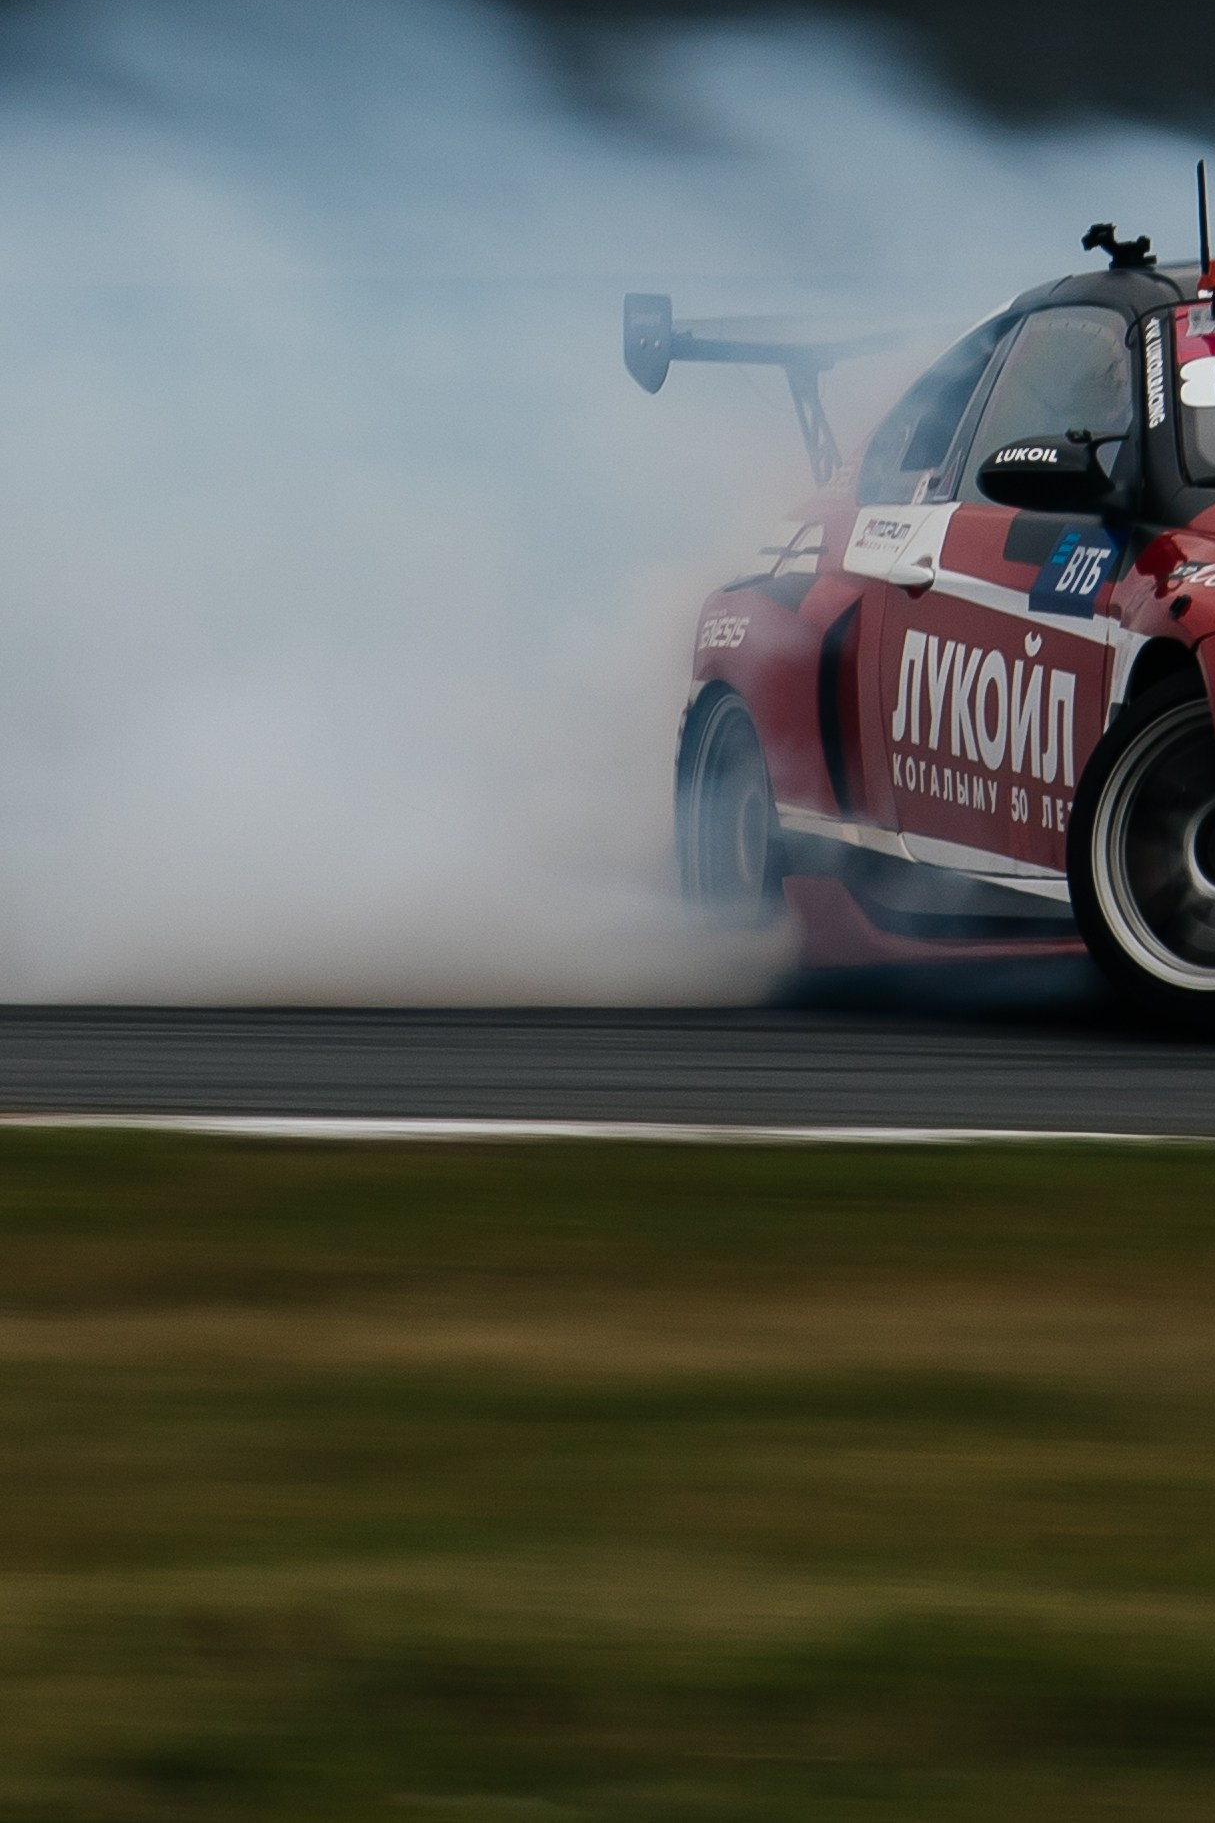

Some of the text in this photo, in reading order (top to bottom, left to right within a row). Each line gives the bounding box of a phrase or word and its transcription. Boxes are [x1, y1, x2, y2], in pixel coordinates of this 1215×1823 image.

[995, 447, 1058, 464] LUKOIL
[1055, 546, 1111, 595] ВТБ
[697, 617, 750, 650] ENESIS
[892, 629, 1076, 788] ЛУКОЙЛ
[893, 752, 998, 814] КОГАЛЫМУ
[1010, 786, 1029, 824] 50
